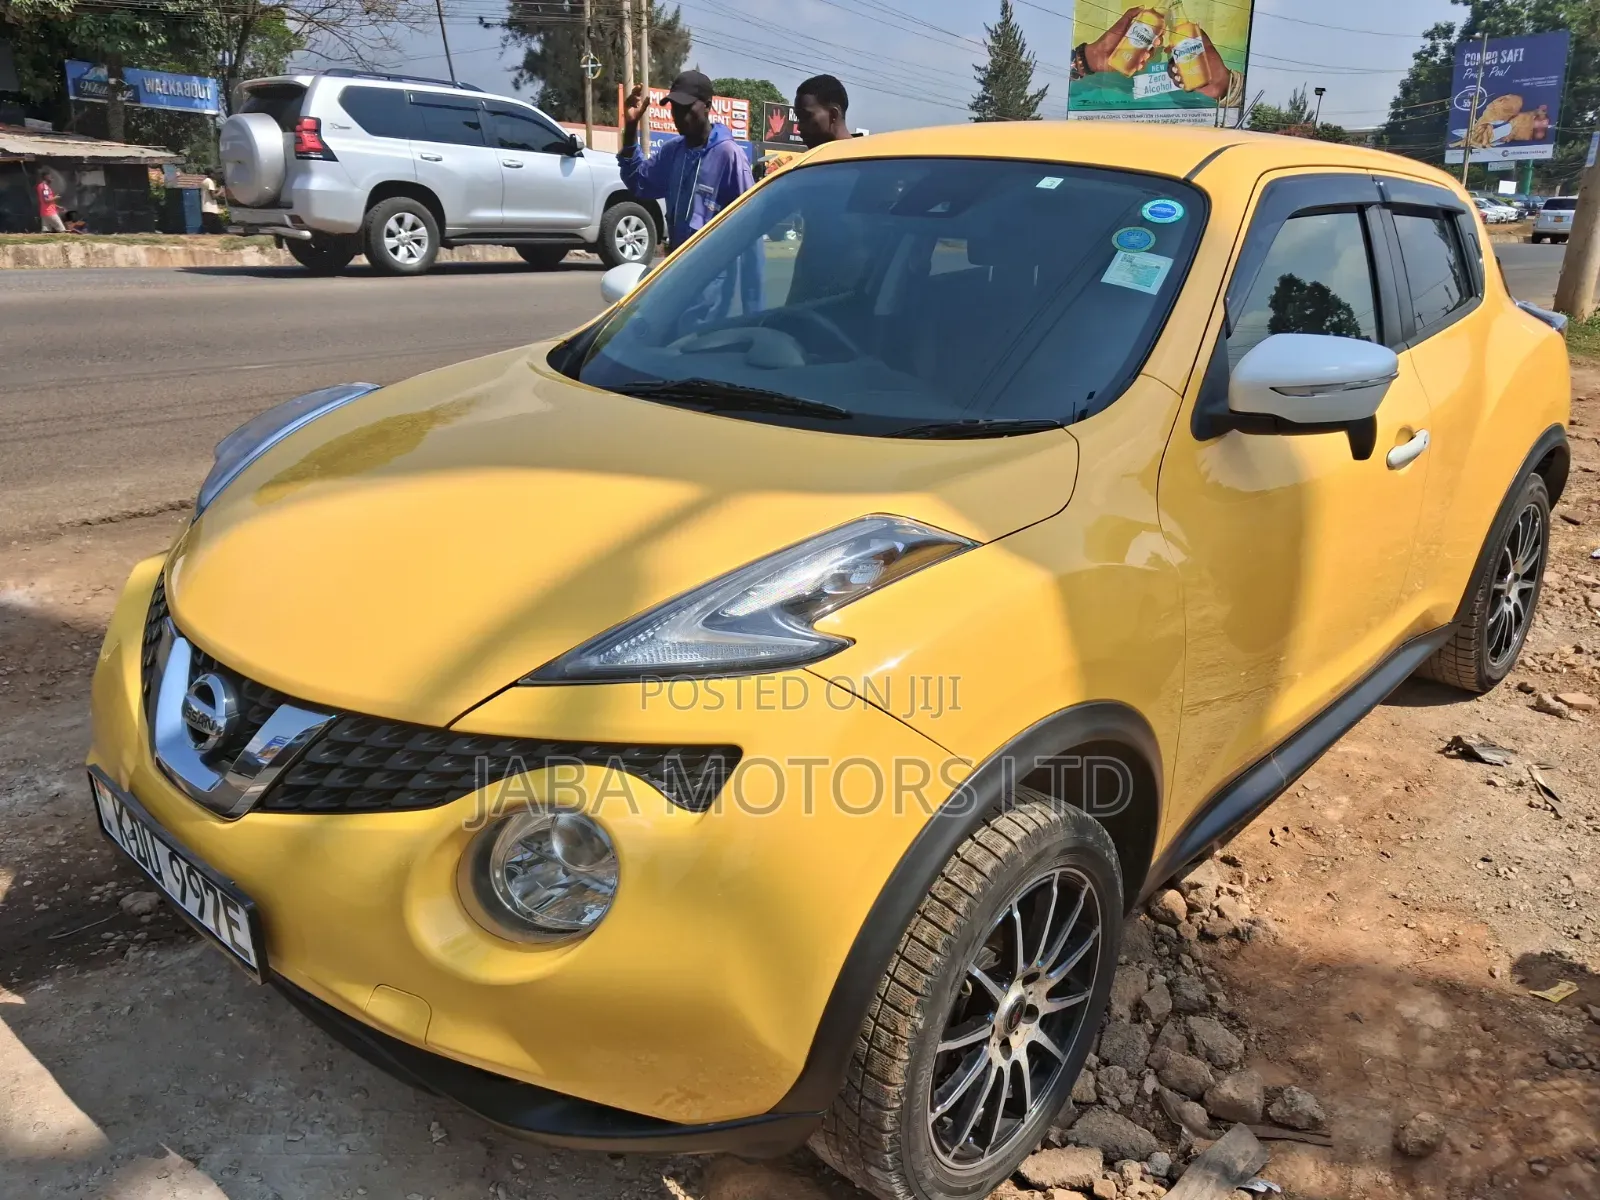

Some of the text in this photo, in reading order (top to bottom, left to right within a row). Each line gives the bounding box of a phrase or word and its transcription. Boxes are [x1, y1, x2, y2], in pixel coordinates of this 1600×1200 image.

[1500, 48, 1525, 64] SAFI
[1151, 64, 1165, 72] NEW
[1148, 74, 1166, 84] Zero
[144, 77, 211, 100] WALKABOUT
[1144, 82, 1172, 94] Alcohol
[649, 107, 672, 119] PAIN
[168, 850, 251, 960] 997E
